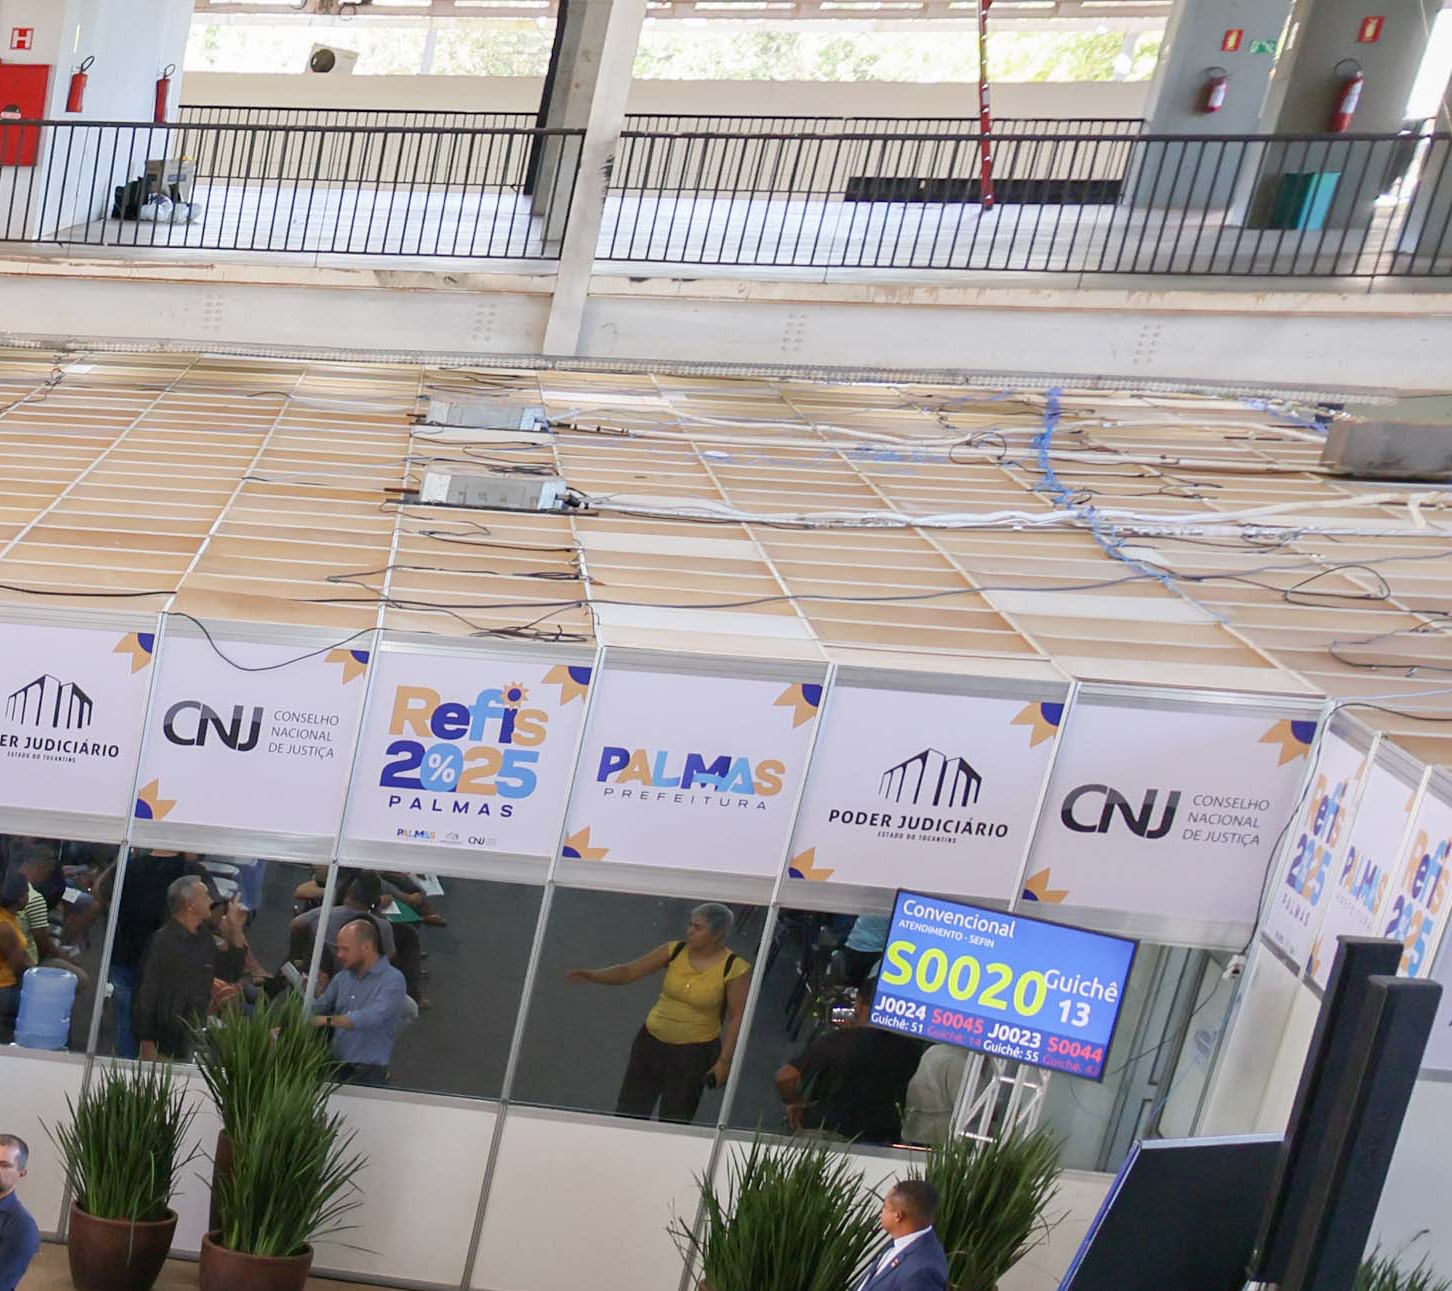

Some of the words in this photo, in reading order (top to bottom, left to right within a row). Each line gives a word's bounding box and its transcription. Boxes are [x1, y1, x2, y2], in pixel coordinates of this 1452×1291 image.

[273, 710, 340, 727] CONSELHO
[388, 680, 549, 747] Refis
[163, 700, 264, 752] CNJ
[271, 726, 333, 743] NACIONAL
[25, 736, 119, 758] JUDICIÁRIO
[267, 742, 285, 754] DE
[286, 743, 334, 760] JUSTIÇA
[379, 740, 540, 800] 2025
[596, 746, 786, 798] PALMAS
[388, 795, 515, 819] PALMAS
[603, 787, 767, 811] PREFEITURA
[1192, 794, 1271, 812] CONSELHO
[828, 808, 892, 828] PODER
[898, 814, 1009, 839] JUDICIÁRIO
[1060, 784, 1182, 840] CNJ
[1187, 811, 1261, 829] NACIONAL
[1182, 828, 1202, 842] DE
[1205, 830, 1261, 847] JUSTIÇA
[903, 899, 1016, 938] Convencional
[899, 920, 963, 941] ATENDIMENTO
[969, 935, 995, 948] SEFIN
[882, 941, 1047, 1016] S0020
[1044, 969, 1118, 1003] Guichê
[875, 996, 927, 1020] J0024
[1059, 1000, 1091, 1027] 13
[871, 1013, 909, 1031] Guichê:
[911, 1022, 924, 1033] 51
[932, 1009, 984, 1034] S0045
[988, 1024, 1041, 1048] J0023
[983, 1040, 1023, 1059] Guichê:
[1025, 1050, 1039, 1062] 55
[1048, 1037, 1102, 1062] S0044
